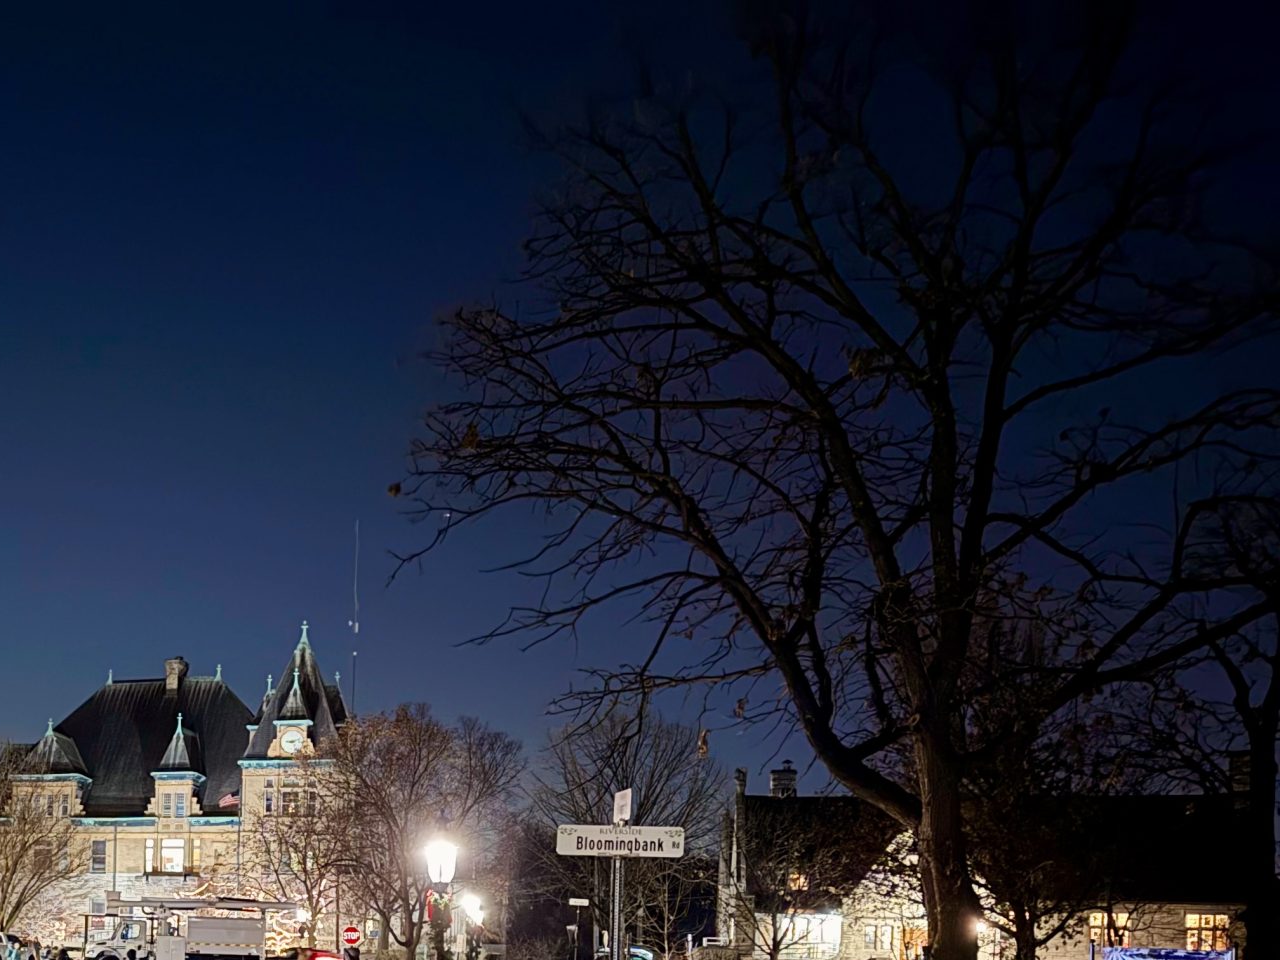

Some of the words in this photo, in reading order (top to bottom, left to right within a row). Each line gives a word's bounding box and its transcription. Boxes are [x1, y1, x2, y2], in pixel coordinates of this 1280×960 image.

[576, 836, 664, 853] Bloomingbank
[672, 841, 680, 849] Rd
[343, 931, 360, 940] STOP
